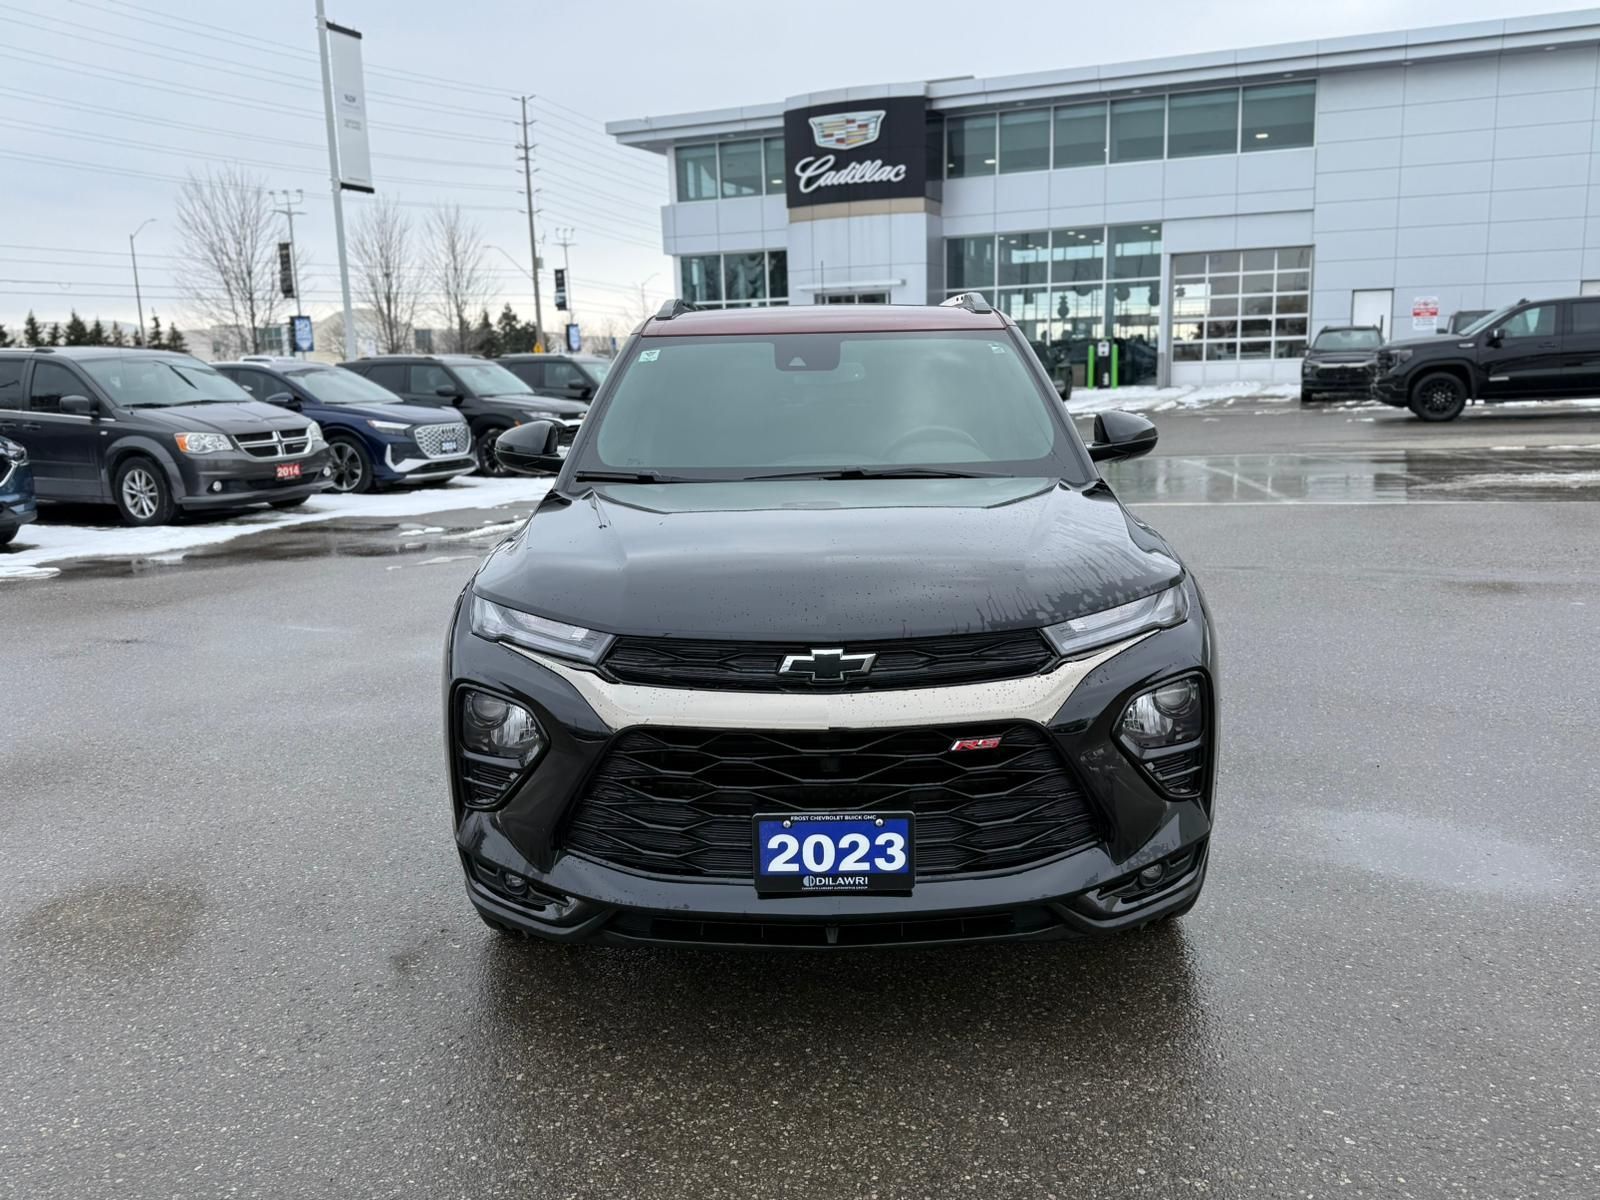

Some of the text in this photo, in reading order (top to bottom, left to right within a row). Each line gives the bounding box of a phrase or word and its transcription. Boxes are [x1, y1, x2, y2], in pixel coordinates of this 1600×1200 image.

[794, 154, 906, 193] Cadillac
[277, 464, 300, 478] 2014
[951, 737, 1001, 751] RS
[767, 832, 906, 872] 2023
[816, 876, 868, 886] DILAWRI
